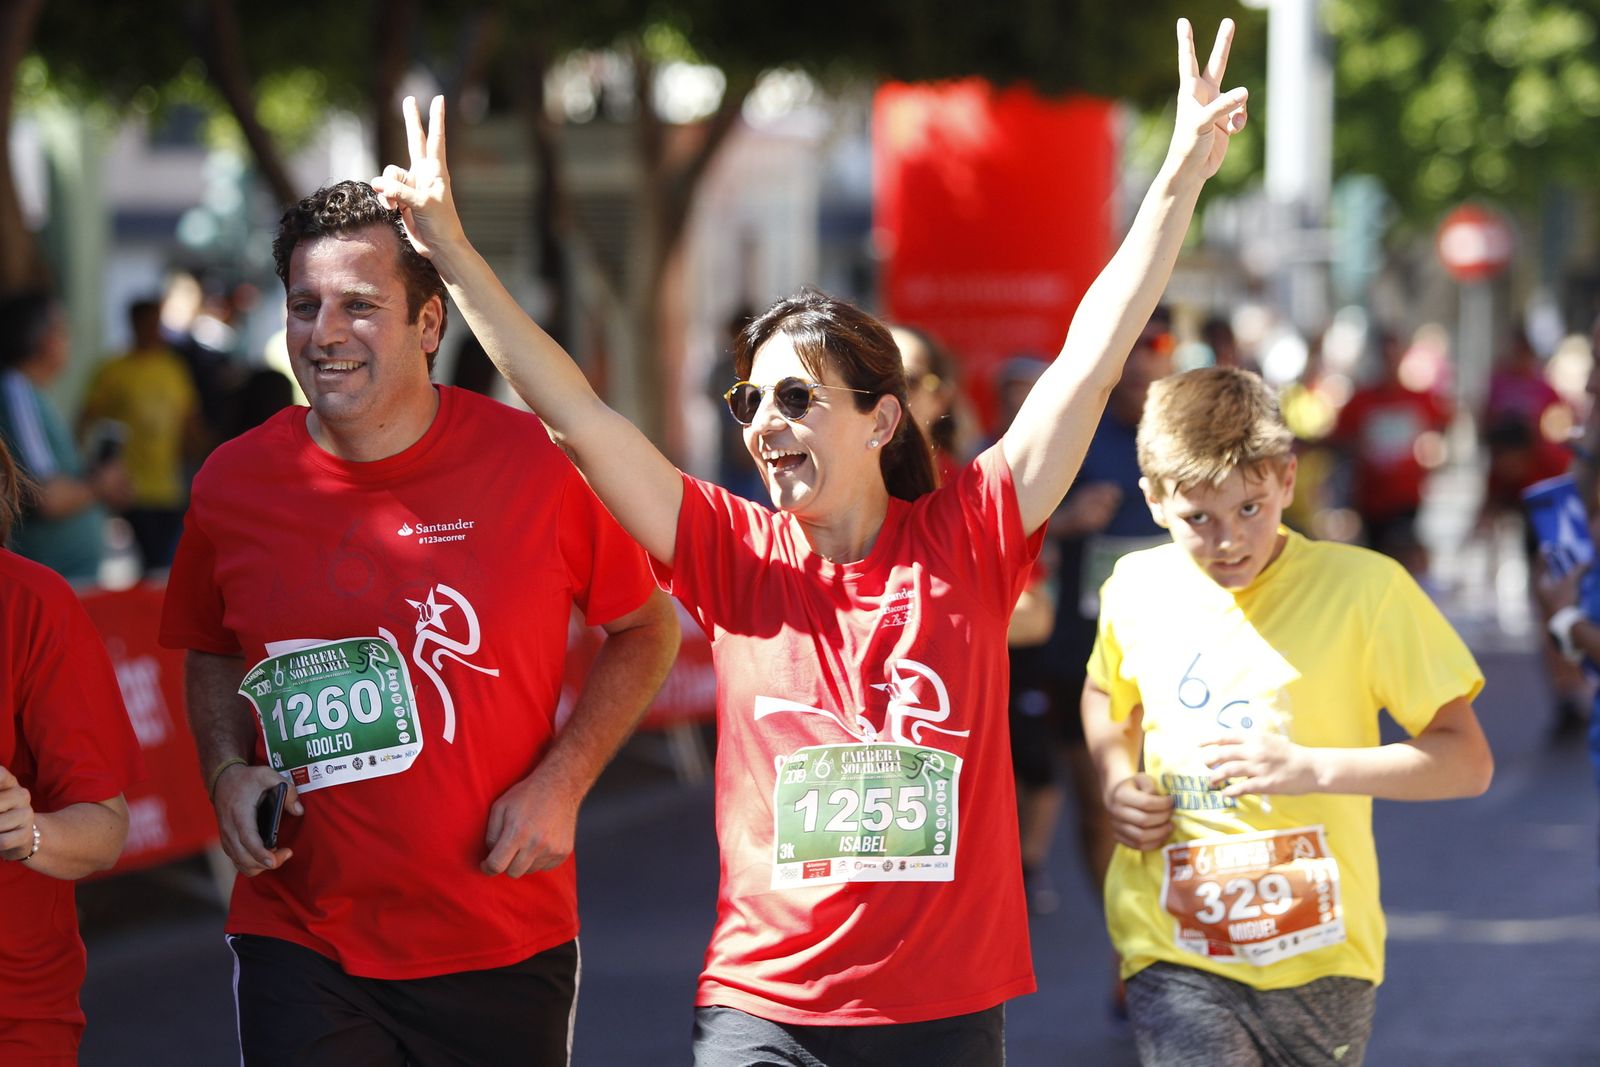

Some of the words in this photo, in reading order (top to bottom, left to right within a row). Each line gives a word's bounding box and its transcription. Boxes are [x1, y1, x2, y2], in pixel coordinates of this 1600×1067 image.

[415, 519, 474, 534] Santander
[418, 534, 466, 544] #123acorrer
[290, 648, 346, 669] CARRERA
[290, 659, 349, 680] SOLIDARIA
[1179, 652, 1210, 709] 6
[271, 679, 383, 741] 1260
[306, 732, 353, 758] ADOLFO
[841, 749, 901, 763] CARRERA
[841, 761, 901, 774] SOLIDARIA
[794, 785, 928, 833] 1255
[839, 835, 887, 853] ISABEL
[1195, 847, 1211, 875] 6
[1195, 873, 1293, 925] 329
[1227, 918, 1279, 943] MIGUEL
